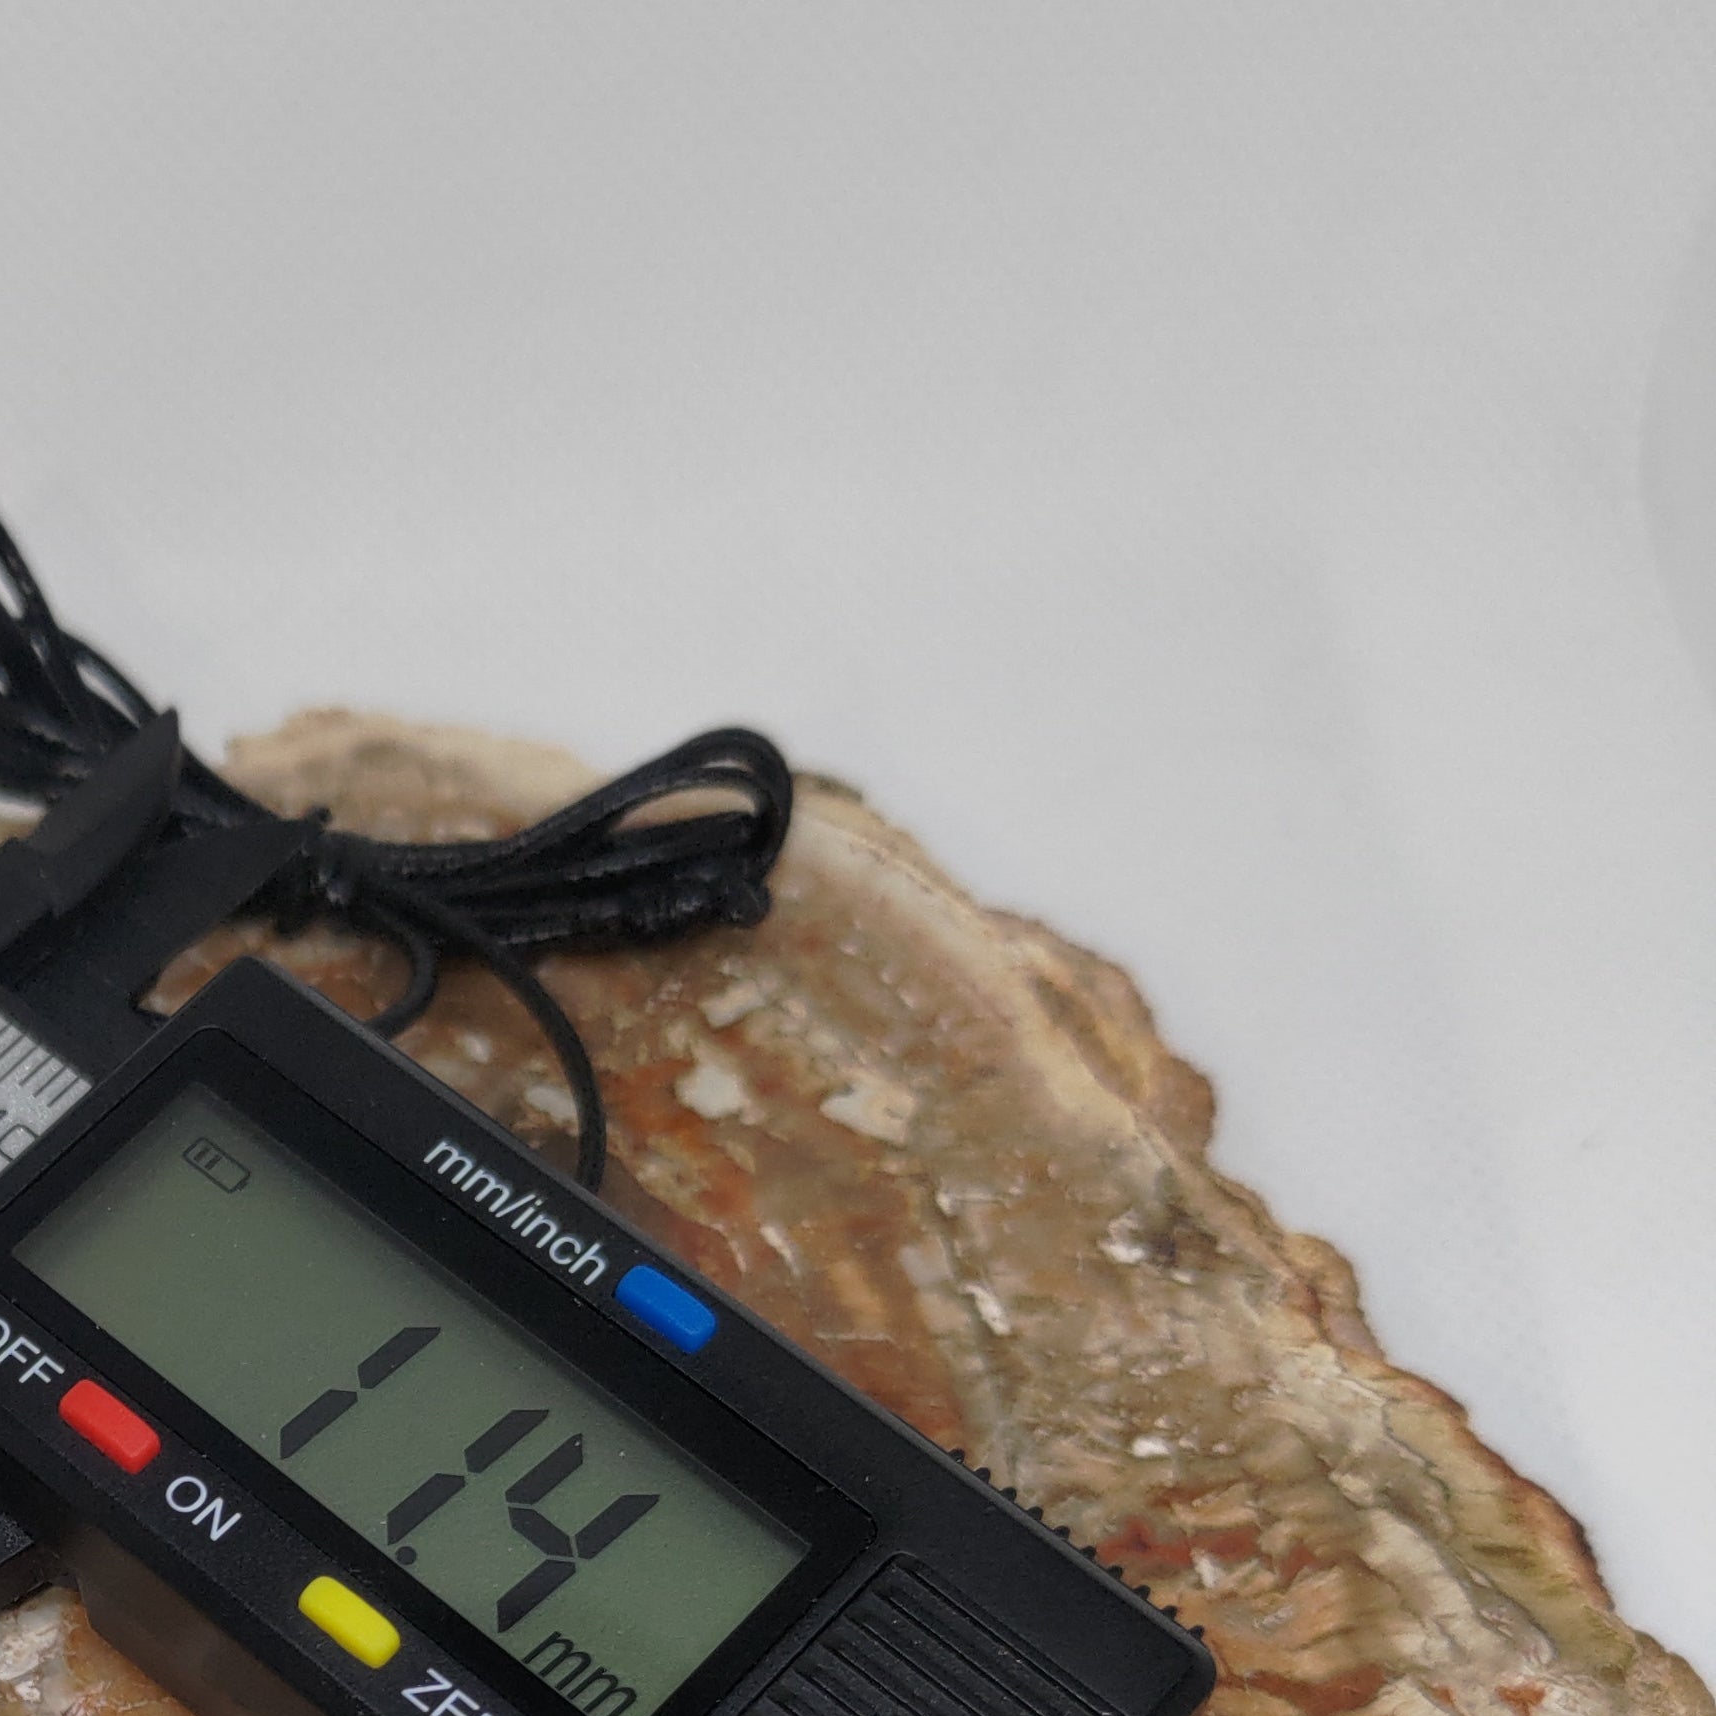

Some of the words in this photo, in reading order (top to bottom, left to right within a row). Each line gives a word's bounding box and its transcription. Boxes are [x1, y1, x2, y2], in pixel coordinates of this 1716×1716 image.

[423, 1140, 606, 1286] mm/inch
[165, 1475, 242, 1542] ON
[280, 1327, 660, 1633] 11.4
